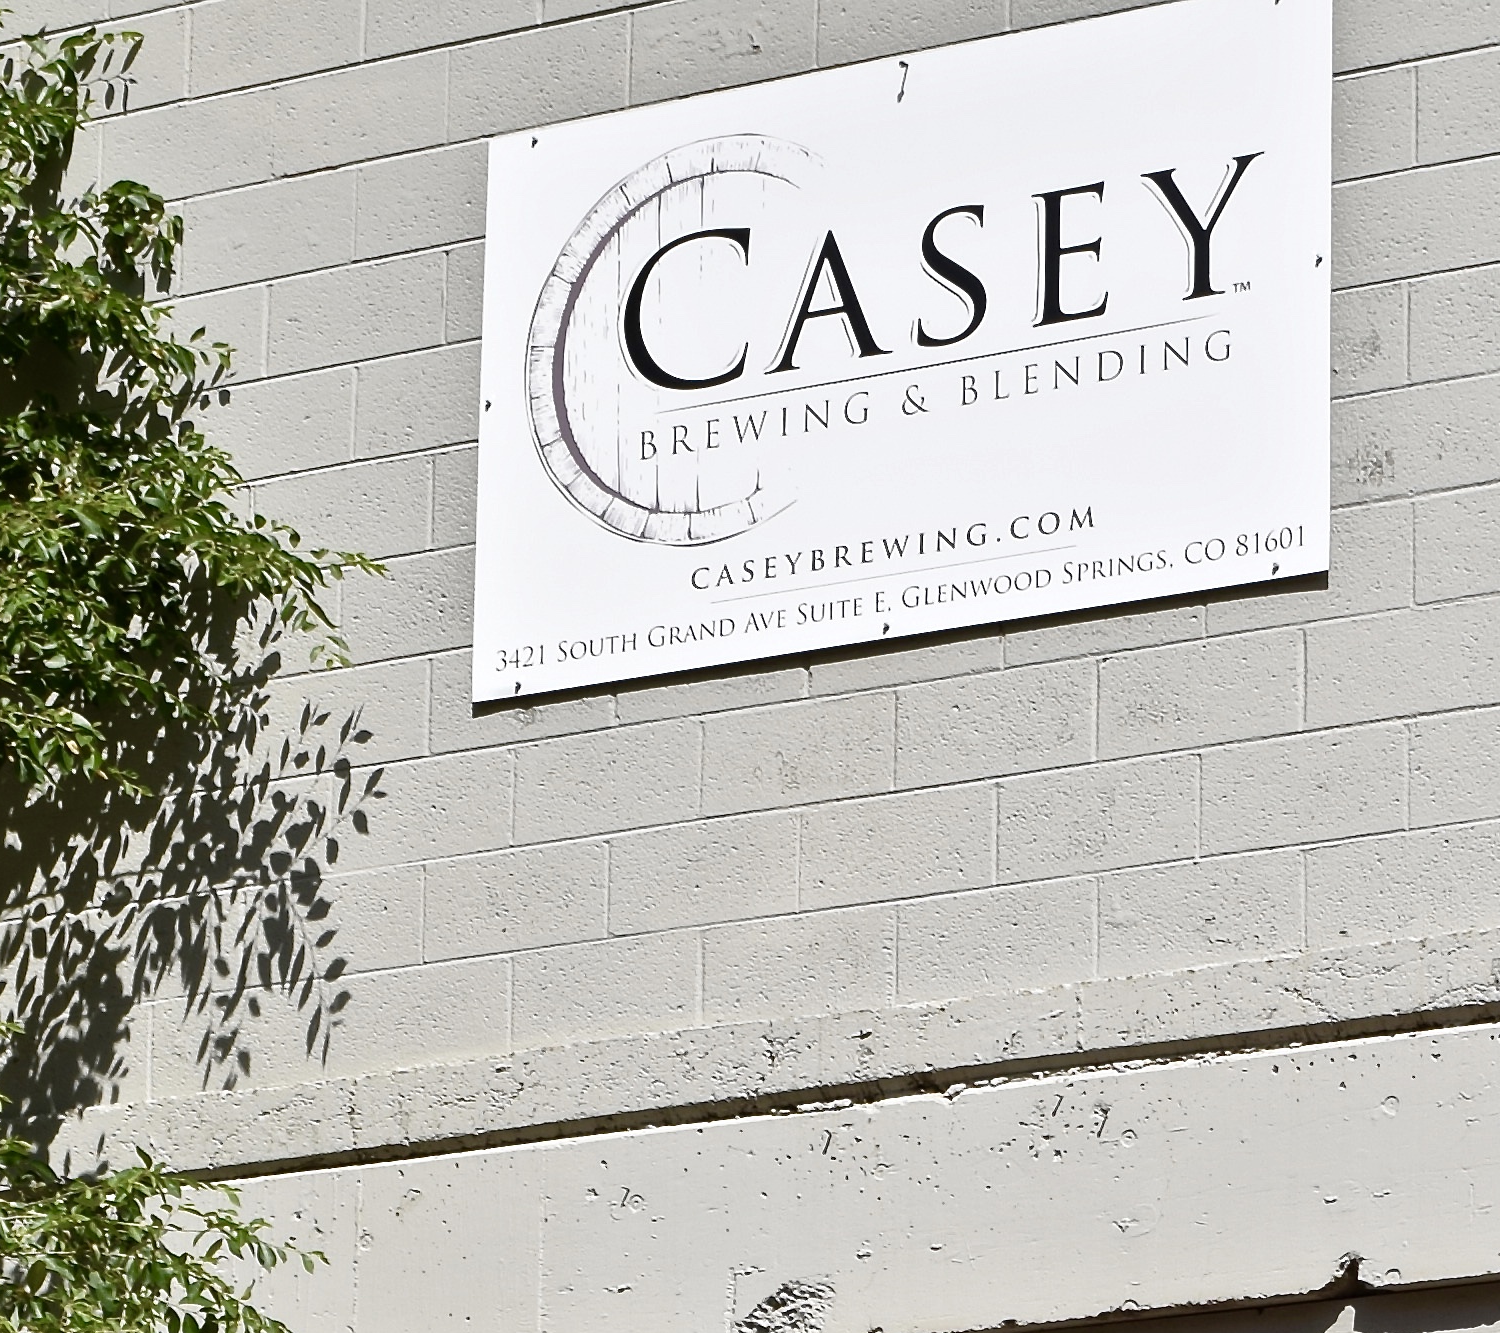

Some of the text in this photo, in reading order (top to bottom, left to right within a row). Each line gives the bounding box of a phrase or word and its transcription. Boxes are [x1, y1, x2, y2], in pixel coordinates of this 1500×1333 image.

[617, 151, 1266, 391] CASEY
[639, 329, 1234, 462] BREWING & BLENDING
[495, 643, 546, 673] 3421
[1184, 537, 1226, 565] CO
[1235, 525, 1307, 558] 81601
[690, 505, 1097, 592] CASEYBREWING.COM
